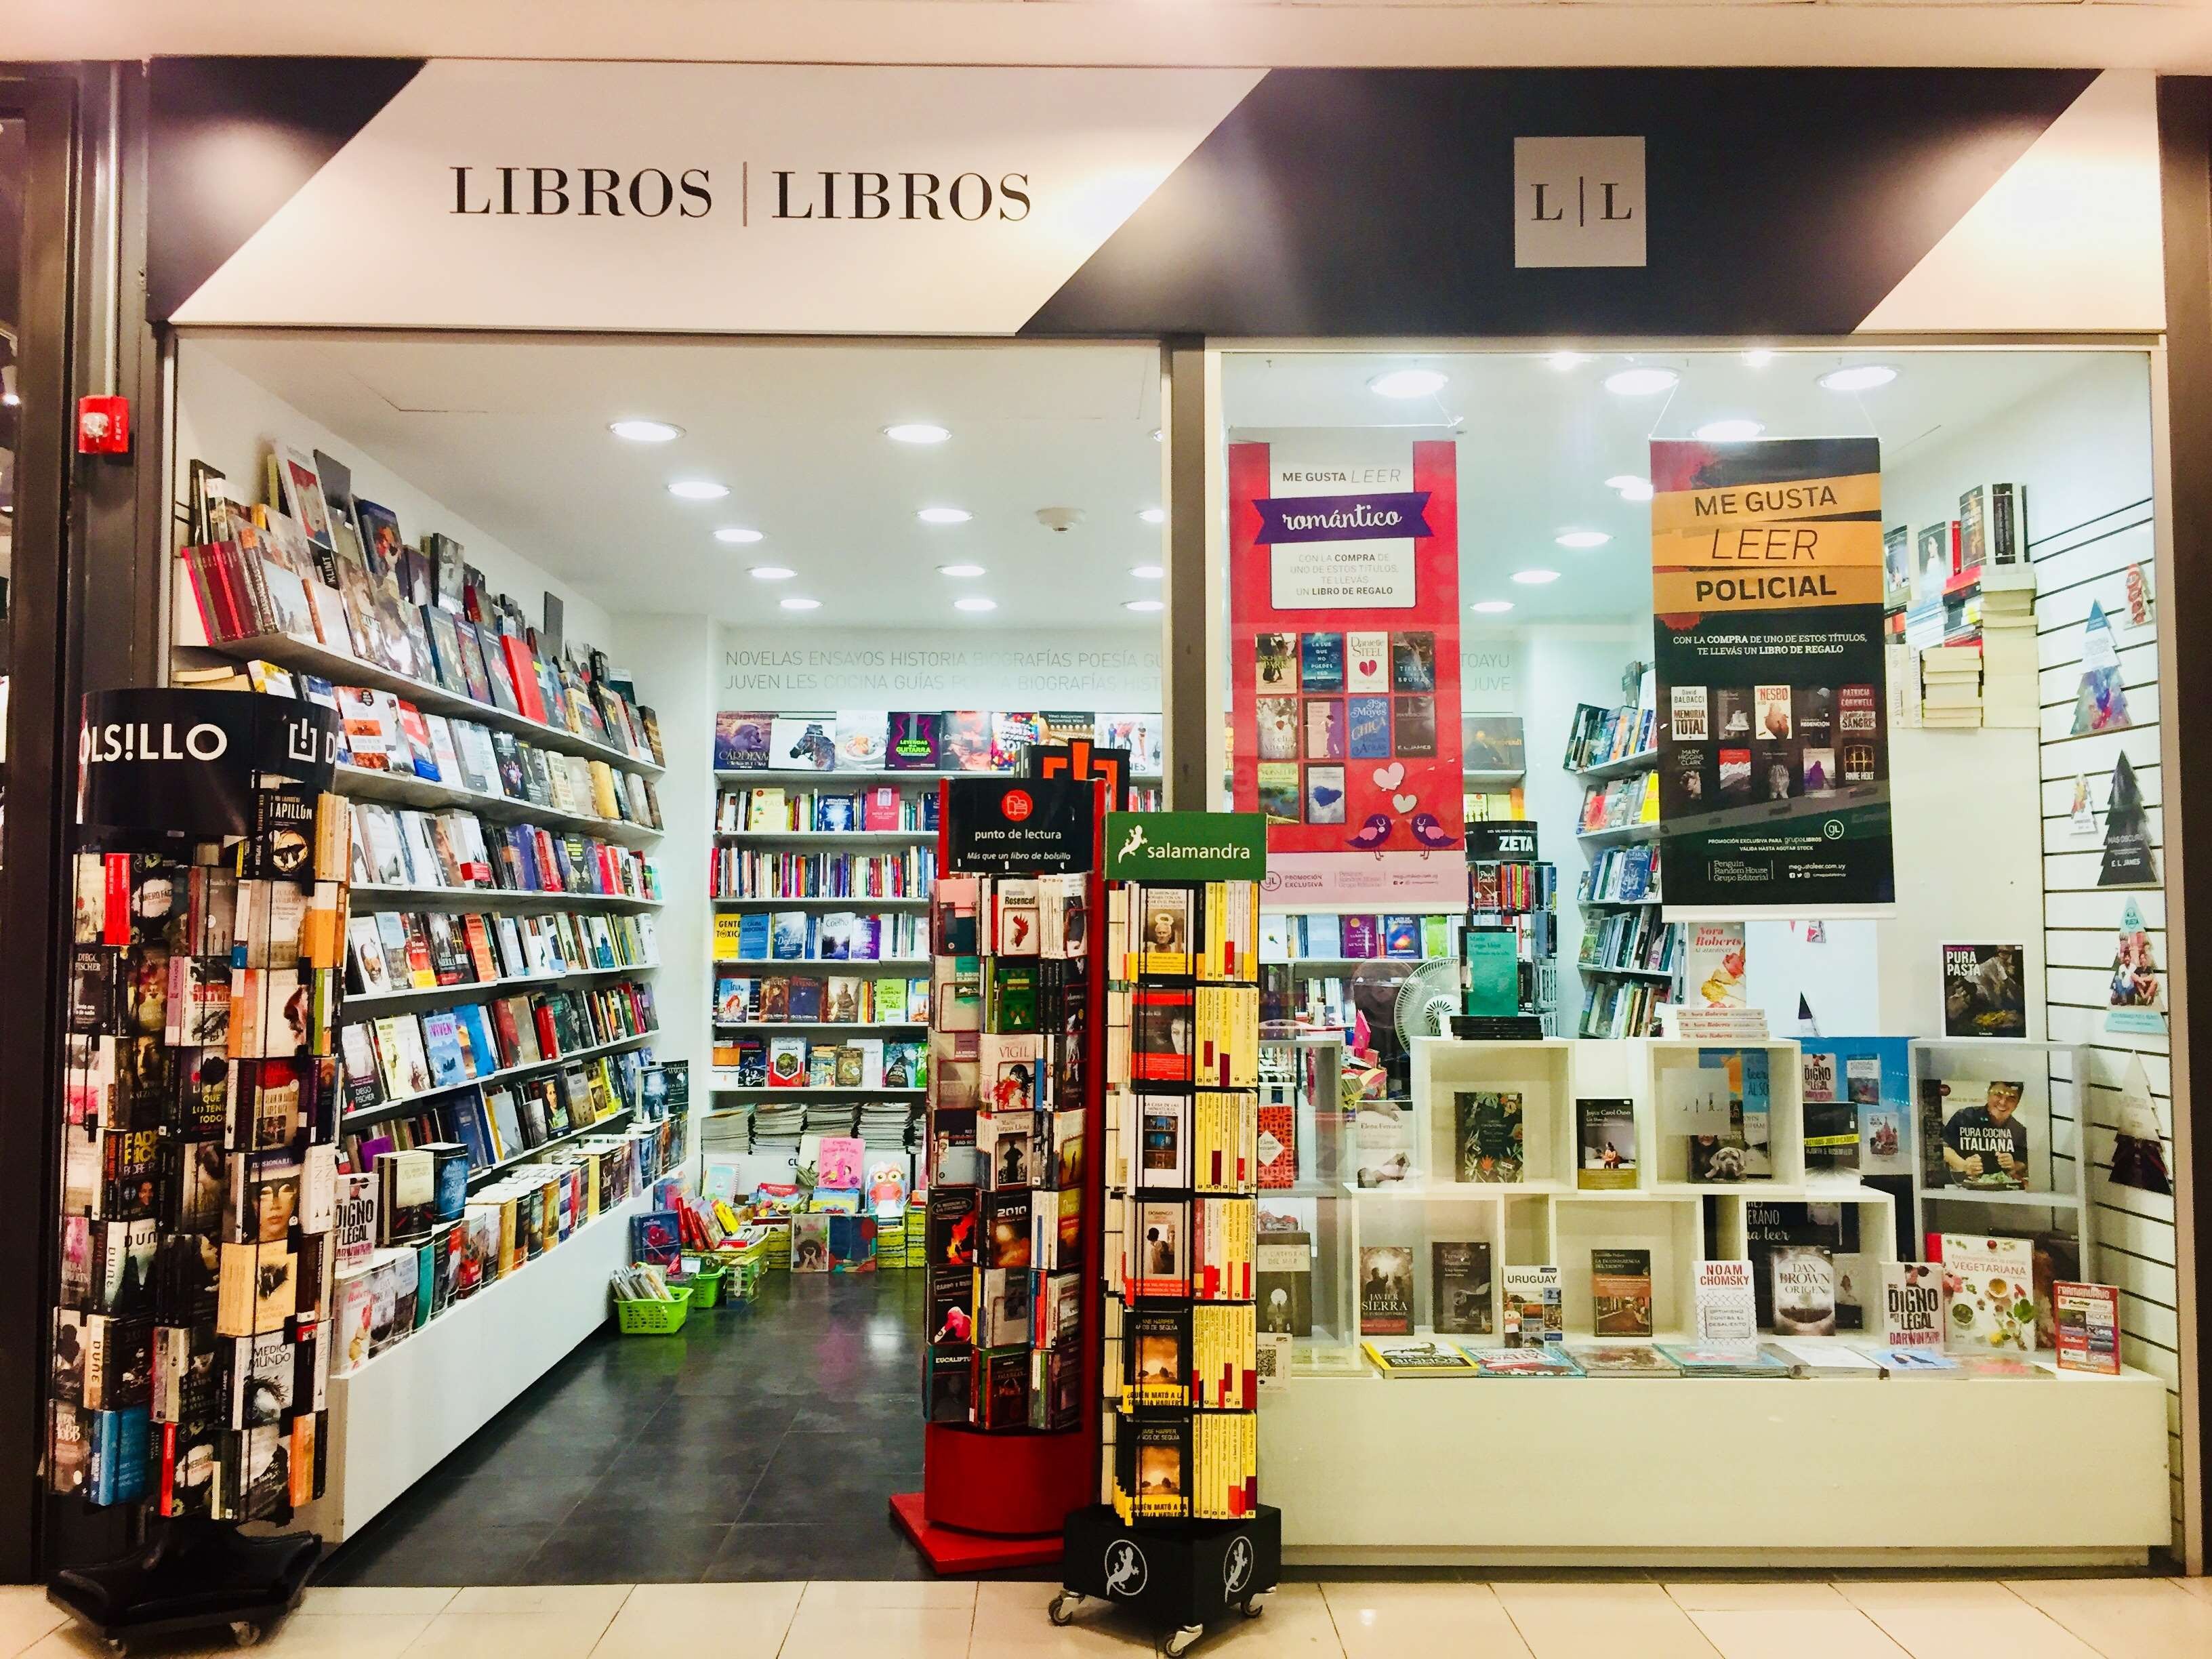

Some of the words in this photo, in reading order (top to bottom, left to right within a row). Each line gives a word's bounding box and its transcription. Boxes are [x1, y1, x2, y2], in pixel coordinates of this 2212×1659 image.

[449, 167, 712, 218] LIBROS
[772, 171, 1031, 222] LIBROS
[1531, 184, 1563, 220] L
[1600, 183, 1631, 220] L
[1282, 472, 1302, 482] ME
[1305, 472, 1347, 482] GUSTA
[1351, 469, 1401, 483] LEER
[1694, 493, 1738, 516] ME
[1746, 485, 1837, 512] GUSTA
[1282, 504, 1403, 530] romántico
[1712, 529, 1818, 560] LEER
[1298, 554, 1318, 562] CON
[1334, 554, 1376, 562] COMPRA
[1378, 553, 1389, 561] DE
[1290, 565, 1310, 574] UNO
[1313, 565, 1326, 573] DE
[1327, 565, 1357, 573] ESTOS
[1321, 576, 1332, 584] TE
[1696, 575, 1837, 602] POLICIAL
[1673, 636, 1692, 644] CON
[1707, 636, 1748, 644] COMPRA
[1763, 635, 1783, 643] UNO
[1799, 634, 1826, 642] ESTOS
[1352, 647, 1383, 657] STEEL
[1759, 646, 1788, 655] LIBRO
[1790, 646, 1803, 654] DE
[1805, 645, 1843, 654] REGALO
[726, 651, 803, 666] NOVELAS
[809, 651, 884, 666] ENSAYOS
[890, 651, 966, 667] HISTORIA
[1078, 649, 1138, 668] POESÍA
[1674, 695, 1704, 703] BALDACCI
[1673, 710, 1705, 719] MEMORIA
[1675, 719, 1706, 735] TOTAL
[1841, 718, 1875, 729] SANGRE
[1860, 771, 1875, 779] HOLT
[975, 830, 1005, 841] punto
[1008, 829, 1021, 839] de
[1025, 829, 1061, 840] lectura
[1499, 836, 1533, 851] ZETA
[967, 852, 980, 860] Más
[982, 853, 995, 861] que
[1011, 852, 1029, 860] libro
[1031, 852, 1042, 860] de
[1044, 851, 1071, 860] bolsillo
[1147, 842, 1250, 859] salamandra
[1713, 860, 1744, 868] Penguin
[1699, 927, 1723, 935] Nora
[1696, 937, 1742, 946] Roberts
[1947, 951, 1977, 964] PURA
[75, 962, 101, 971] FISCHER
[1947, 963, 1981, 976] PASTA
[1805, 1067, 1831, 1081] DIGNO
[355, 1086, 371, 1096] DIEGO
[203, 1094, 221, 1103] QUE
[355, 1093, 375, 1103] FISCHER
[200, 1115, 223, 1124] TODO
[1960, 1127, 1981, 1137] PURA
[1983, 1128, 2012, 1138] COCINA
[1960, 1137, 2014, 1152] ITALIANA
[997, 1206, 1027, 1217] 2010
[342, 1225, 369, 1246] LEGAL
[1764, 1227, 1790, 1241] leer
[1706, 1265, 1742, 1275] NOAM
[1952, 1261, 2026, 1275] VEGETARIANA
[1507, 1275, 1557, 1284] URUGUAY
[1700, 1275, 1749, 1286] CHOMSKY
[1779, 1273, 1830, 1284] BROWN
[1361, 1301, 1408, 1311] SIERRA
[1889, 1288, 1938, 1313] DIGNO
[1901, 1313, 1934, 1330] LEGAL
[254, 1344, 287, 1357] MEDIO
